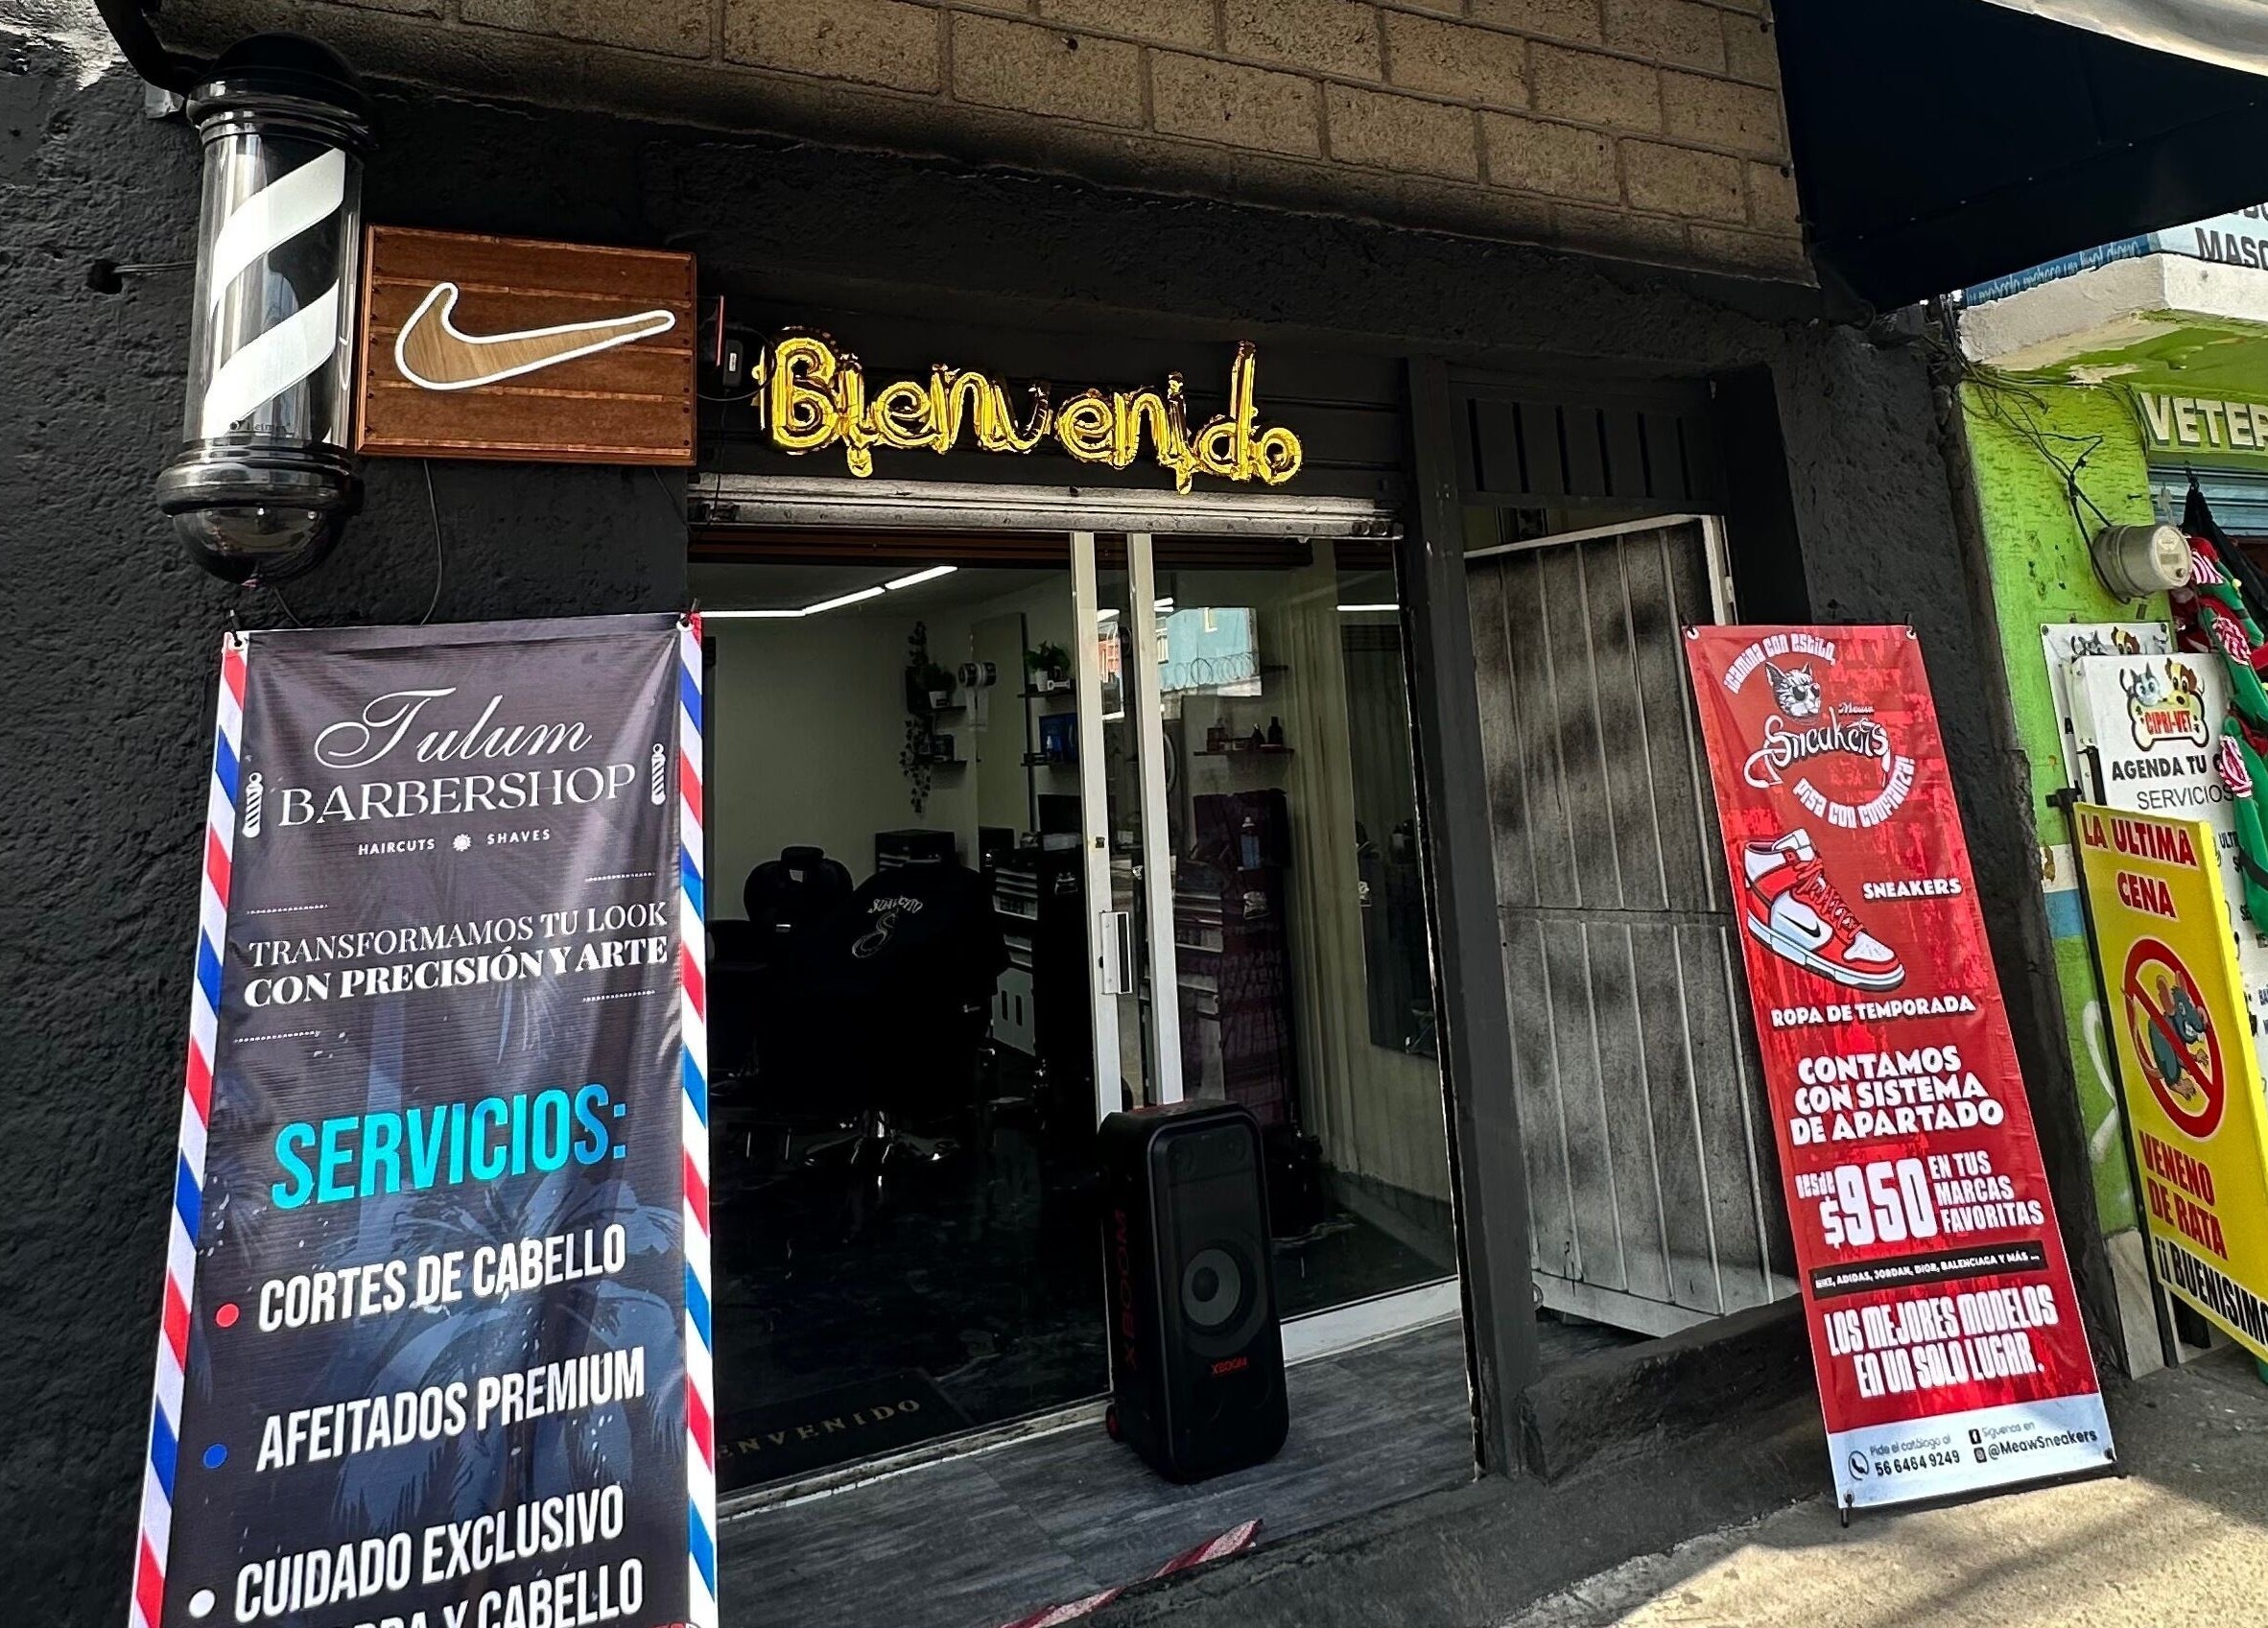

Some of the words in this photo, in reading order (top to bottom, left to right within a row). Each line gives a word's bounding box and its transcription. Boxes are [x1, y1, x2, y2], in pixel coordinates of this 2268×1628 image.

[315, 687, 592, 768] Tulum
[1743, 706, 1891, 789] Sneakers
[278, 764, 636, 827] BARBERSHOP
[2112, 755, 2185, 782] AGENDA
[2186, 754, 2208, 774] TU
[2137, 784, 2233, 811] SERVICIOS
[358, 838, 436, 856] HAIRCUTS
[486, 828, 551, 846] SHAVES
[2080, 814, 2109, 850] LA
[2110, 818, 2198, 869] ULTIMA
[1863, 878, 1962, 900] SNEAKERS
[2116, 872, 2178, 921] CENA
[249, 917, 533, 969] TRANSFORMAMOS
[540, 910, 578, 938] TU
[586, 901, 668, 932] LOOK
[245, 973, 330, 1008] CON
[341, 946, 543, 1000] PRECISIÓN
[543, 947, 574, 975] Y
[576, 935, 668, 968] ARTE
[1771, 1006, 1824, 1027] ROPA
[1827, 1003, 1852, 1024] DE
[1855, 995, 1976, 1022] TEMPORADA
[1798, 1045, 1962, 1086] CONTAMOS
[1794, 1083, 1855, 1116] CON
[1856, 1072, 1989, 1109] SISTEMA
[272, 1083, 627, 1210] SERVICIOS:
[1789, 1116, 1827, 1146] DE
[1831, 1099, 2005, 1141] APARTADO
[1927, 1154, 1949, 1180] EN
[1951, 1150, 1992, 1176] TUS
[1933, 1175, 2015, 1206] MARCAS
[2138, 1128, 2216, 1208] VENENO
[1819, 1157, 1938, 1249] $950
[1939, 1200, 2044, 1234] FAVORITAS
[2146, 1175, 2175, 1227] DE
[2173, 1192, 2229, 1262] RATA
[258, 1261, 406, 1333] CORTES
[416, 1251, 466, 1306] DE
[473, 1224, 626, 1298] CABELLO
[1997, 1253, 2005, 1263] Y
[1824, 1309, 1864, 1357] LOS
[1862, 1296, 1960, 1350] MEJORES
[1957, 1285, 2058, 1336] MODELOS
[1854, 1352, 1886, 1399] EN
[1880, 1346, 1917, 1394] UN
[1914, 1340, 1970, 1388] SOLO
[1965, 1332, 2045, 1382] LUGAR.
[255, 1382, 466, 1473] AFEITADOS
[479, 1346, 645, 1432] PREMIUM
[1928, 1450, 1961, 1467] 9249
[1988, 1429, 2098, 1460] @MeawSneakers
[235, 1531, 412, 1623] CUIDADO
[421, 1484, 625, 1585] EXCLUSIVO
[478, 1558, 644, 1628] CABELLO
